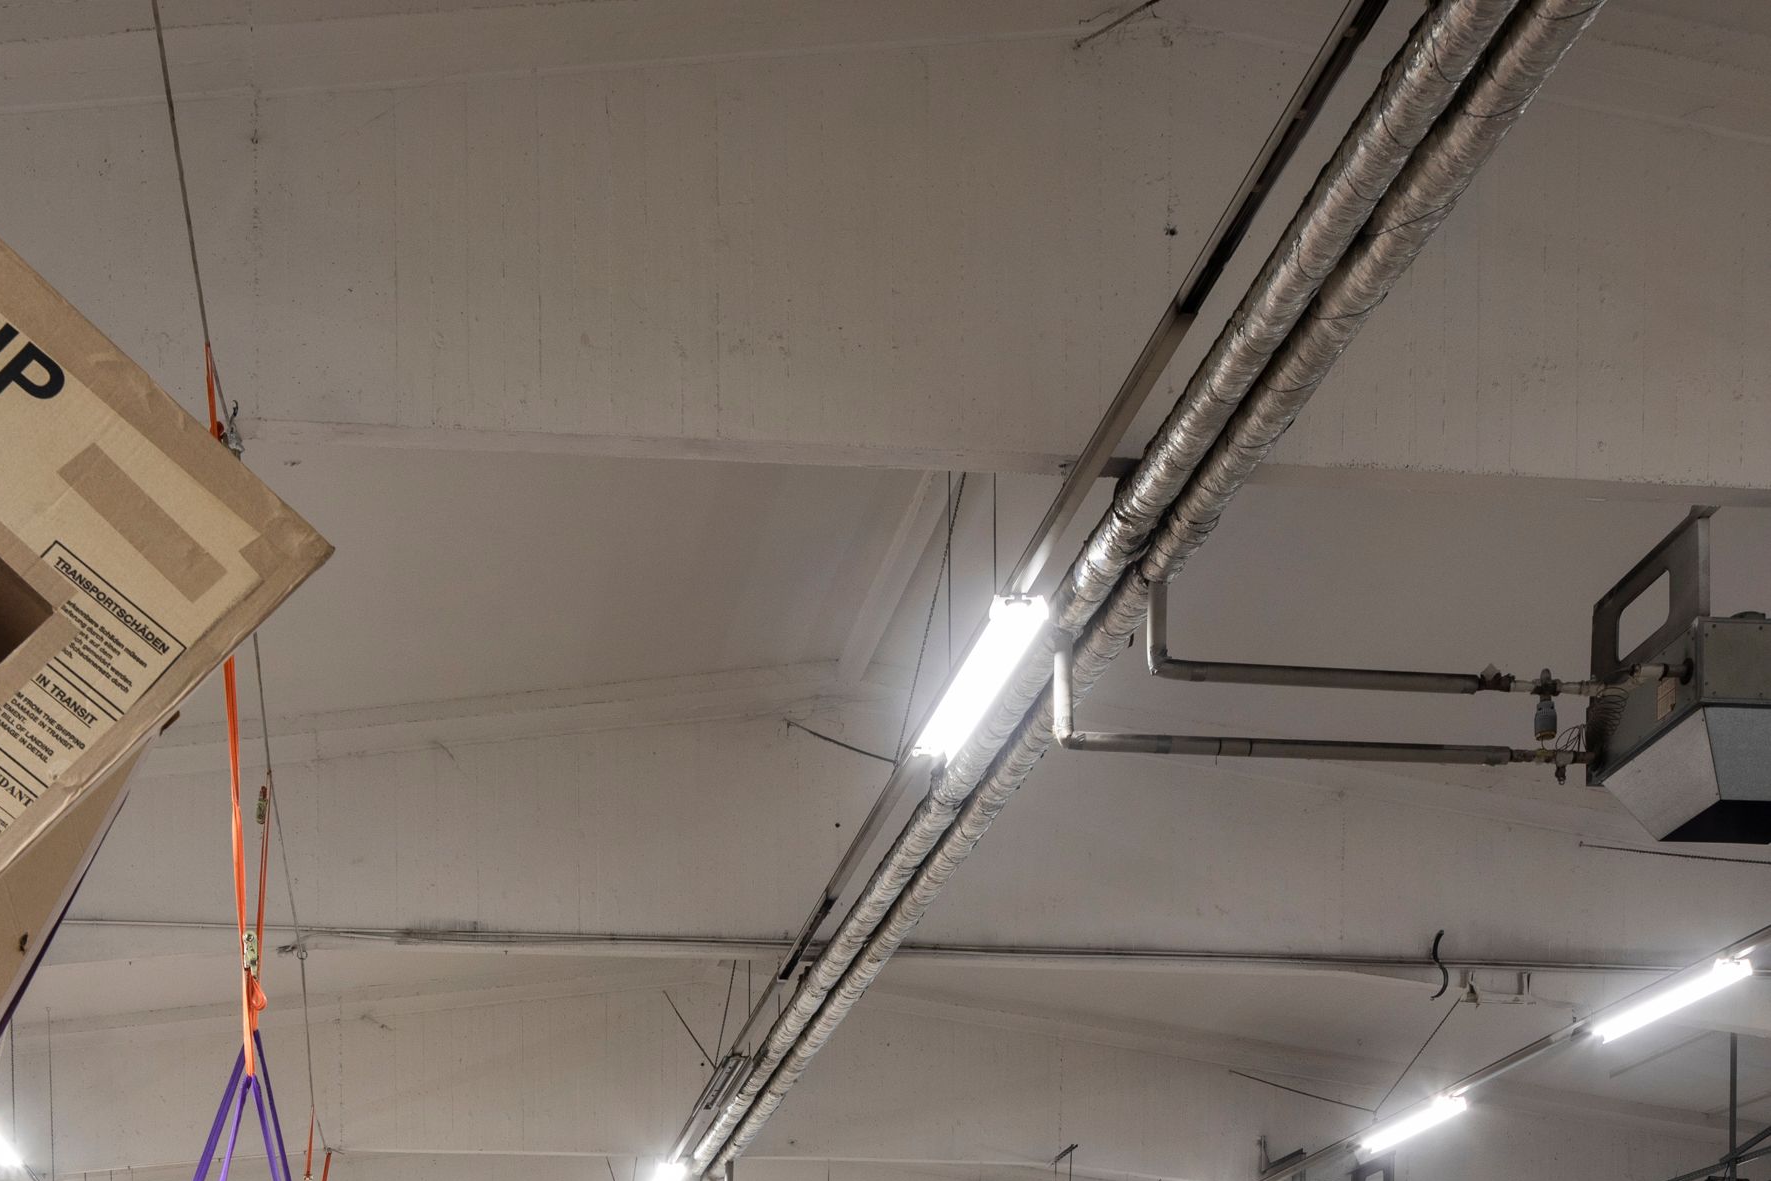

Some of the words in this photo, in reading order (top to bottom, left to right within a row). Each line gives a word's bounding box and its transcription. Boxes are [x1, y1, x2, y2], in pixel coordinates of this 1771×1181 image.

[54, 556, 170, 654] TRANSPORTSCHÄDEN
[85, 625, 104, 643] durch
[10, 698, 38, 723] DAMAGE
[37, 719, 46, 729] IN
[45, 726, 73, 751] TRANSIT
[21, 697, 42, 715] FROM
[41, 713, 56, 726] THE
[54, 723, 85, 750] SHIPPING
[35, 673, 50, 688] IN
[48, 684, 97, 726] TRANSIT
[0, 711, 16, 726] BILL
[14, 723, 26, 734] OF
[24, 731, 53, 756] LANDING
[18, 736, 27, 746] IN
[25, 742, 49, 763] DETAIL
